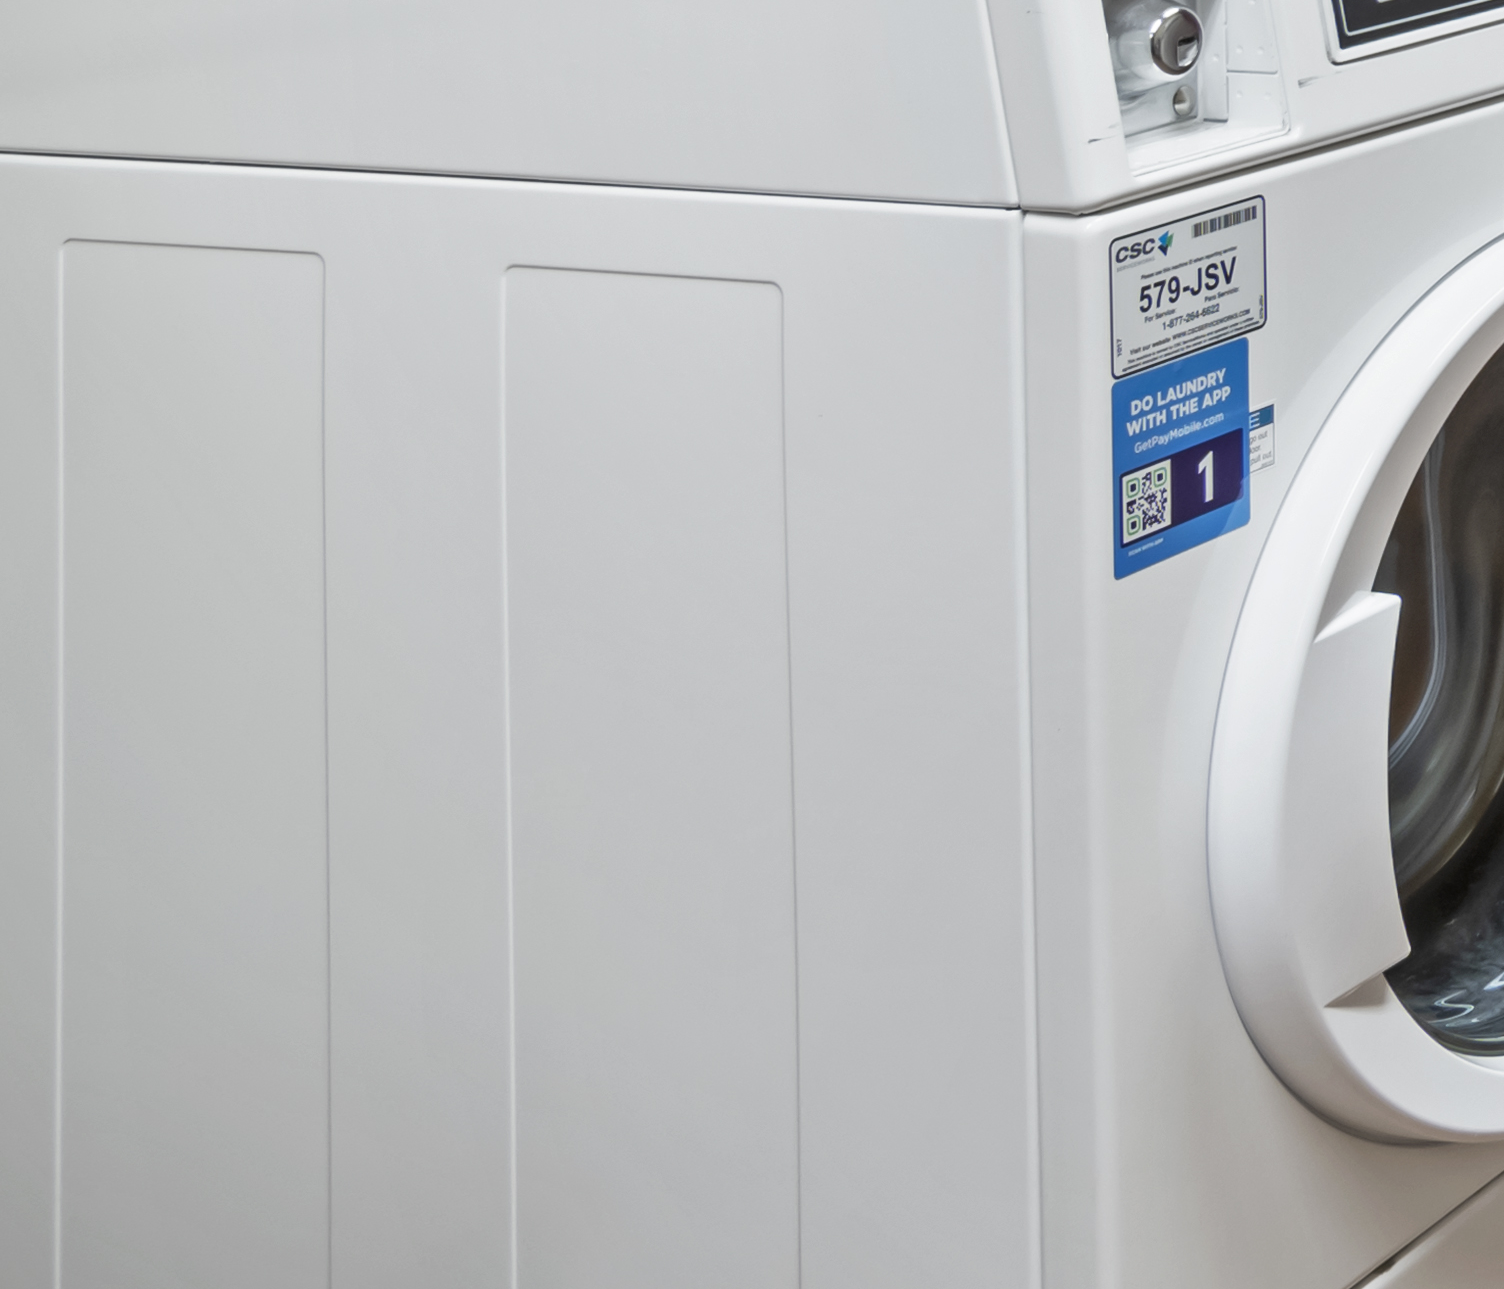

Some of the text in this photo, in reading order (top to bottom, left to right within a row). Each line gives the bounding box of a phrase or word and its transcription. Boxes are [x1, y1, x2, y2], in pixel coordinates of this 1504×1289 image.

[1115, 238, 1156, 264] CSC
[1139, 256, 1237, 313] 579-JSV
[1144, 316, 1154, 324] For
[1126, 385, 1231, 437] WITH THE APP
[1130, 368, 1227, 417] DO LAUNDRY
[1134, 412, 1225, 454] GetPayMobile.com
[1258, 430, 1268, 440] out
[1198, 450, 1214, 503] 1
